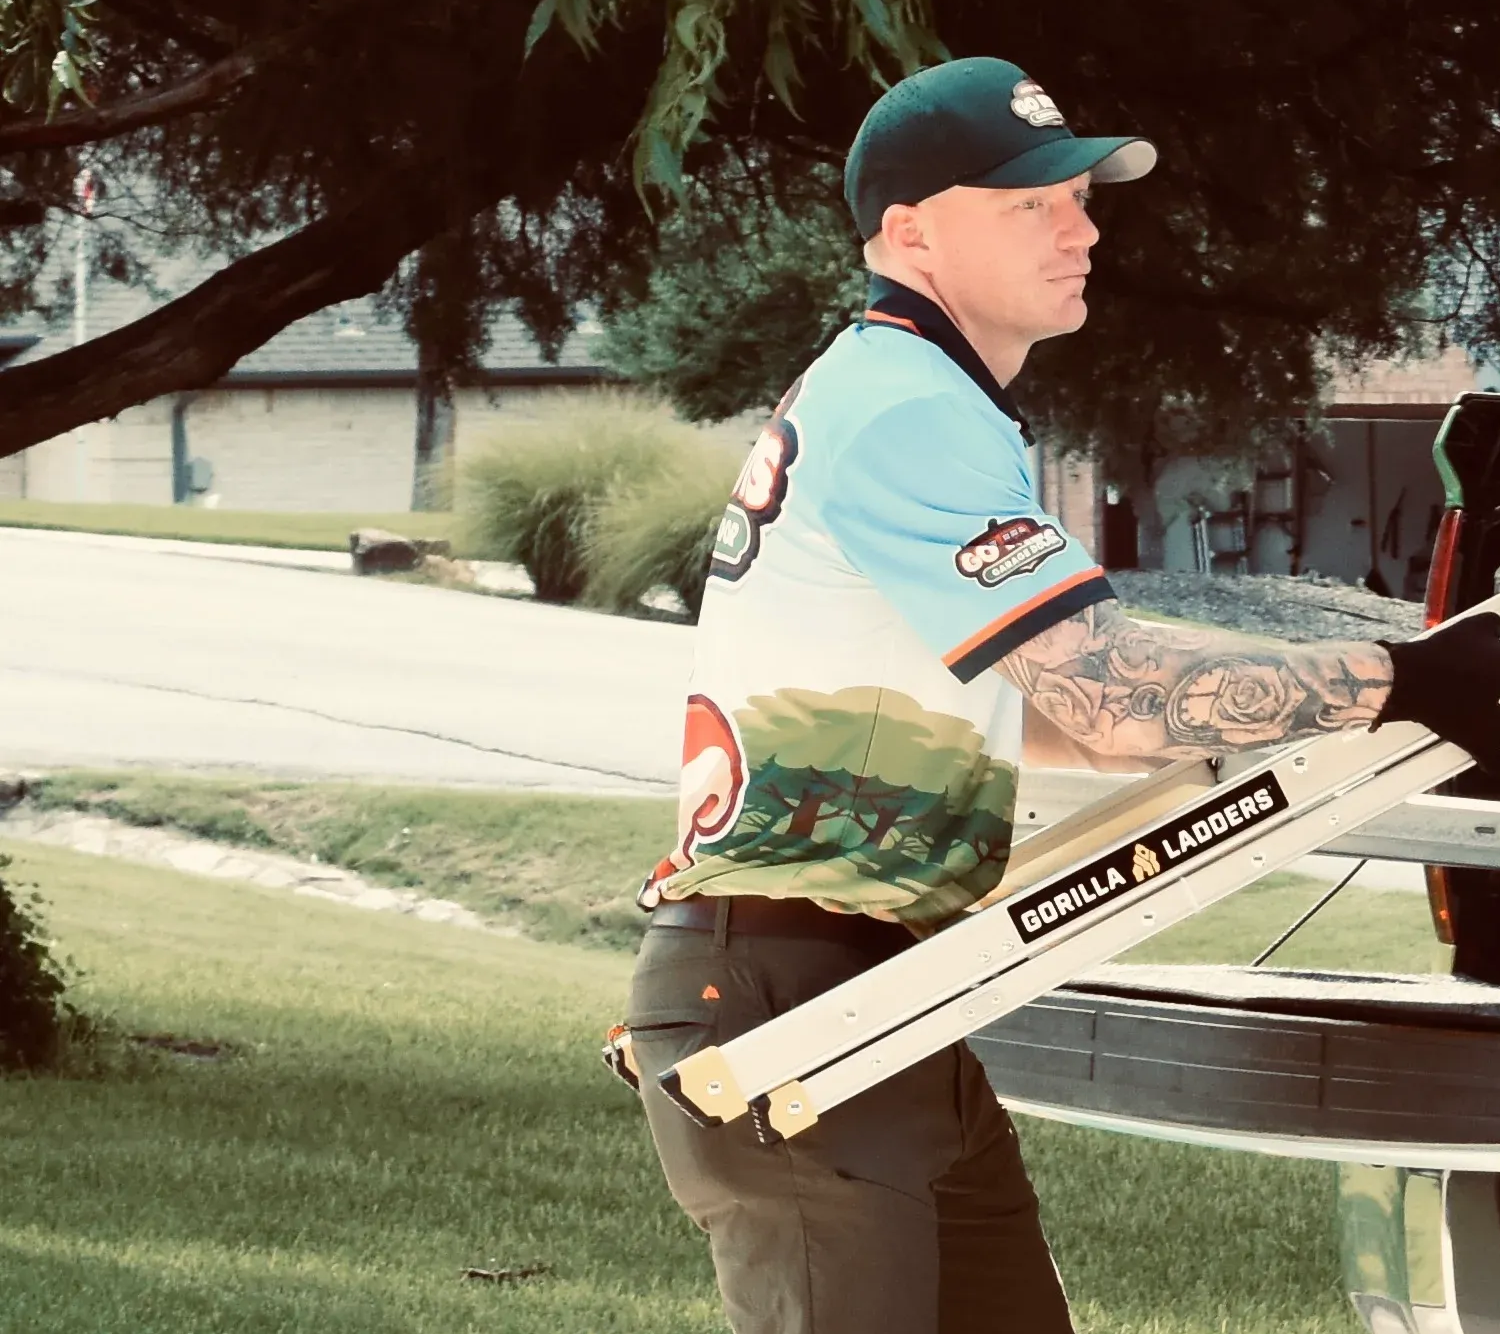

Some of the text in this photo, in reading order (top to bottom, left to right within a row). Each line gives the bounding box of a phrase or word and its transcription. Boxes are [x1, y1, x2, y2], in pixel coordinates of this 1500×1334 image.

[961, 544, 1000, 573] GO
[1020, 788, 1274, 934] GORILLA LADDERS
